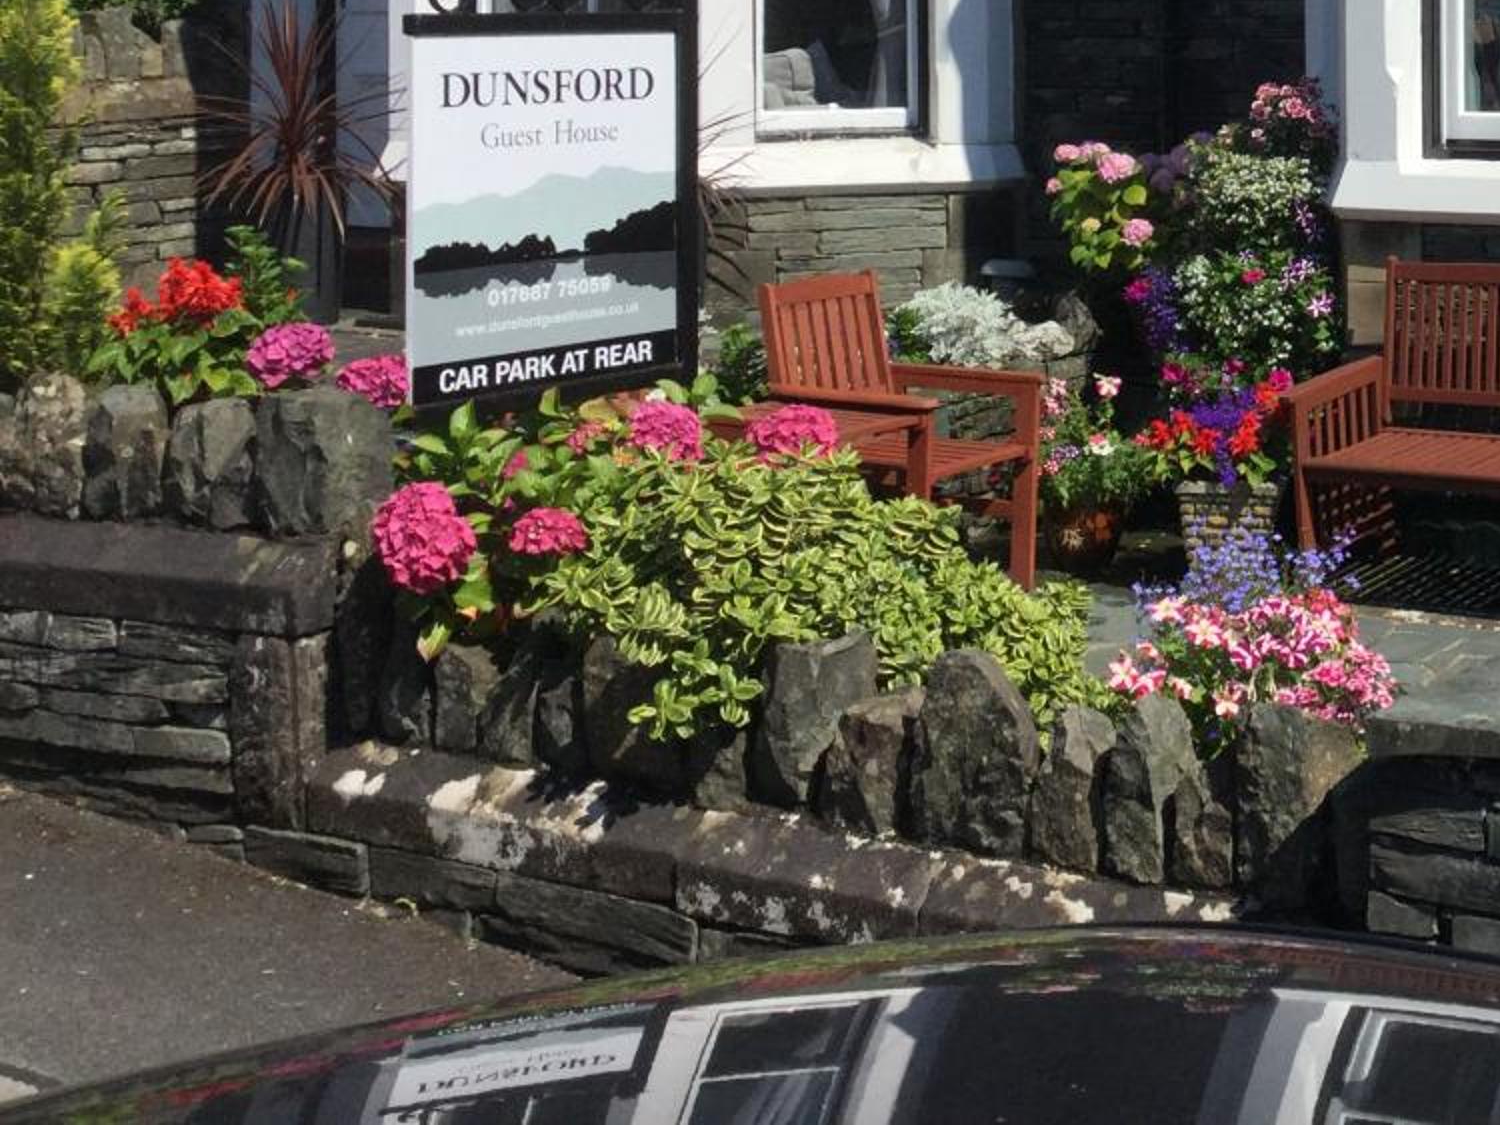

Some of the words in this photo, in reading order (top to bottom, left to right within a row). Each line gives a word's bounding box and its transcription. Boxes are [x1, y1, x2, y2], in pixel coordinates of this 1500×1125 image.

[440, 66, 655, 108] DUNSFORD
[480, 122, 544, 149] Guest
[553, 119, 619, 146] House
[438, 364, 488, 393] CAR
[495, 354, 556, 385] PARK
[560, 349, 588, 375] AT
[594, 339, 653, 370] REAR
